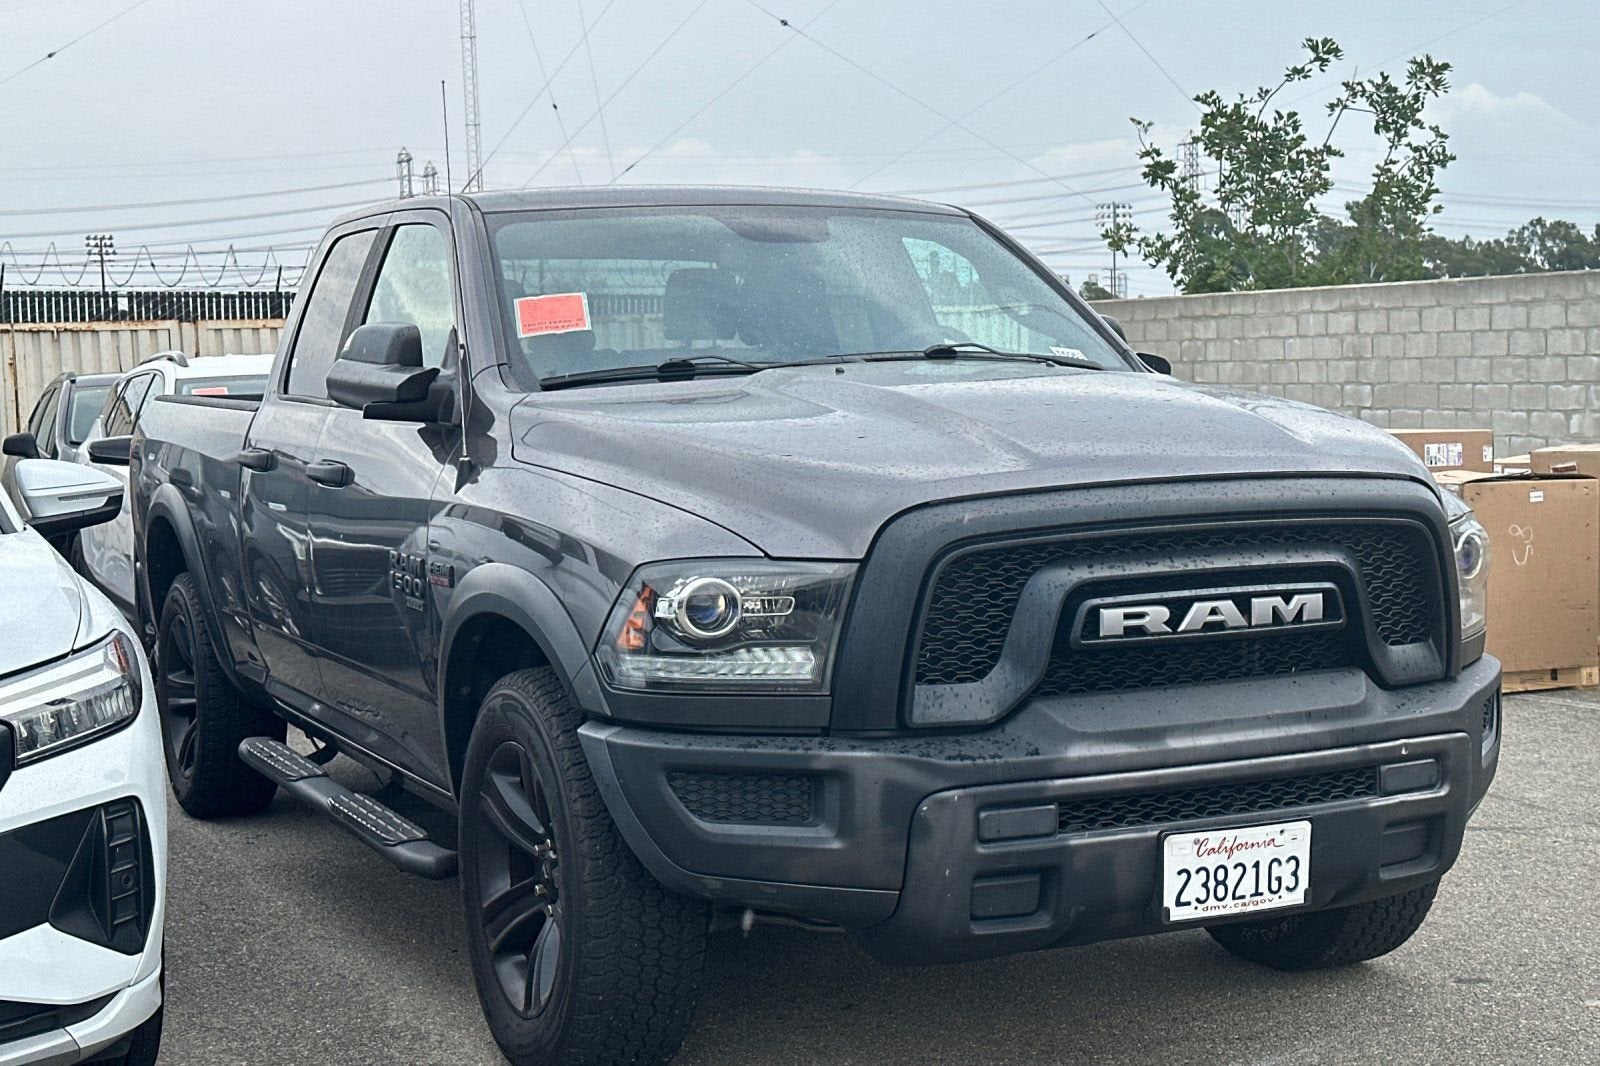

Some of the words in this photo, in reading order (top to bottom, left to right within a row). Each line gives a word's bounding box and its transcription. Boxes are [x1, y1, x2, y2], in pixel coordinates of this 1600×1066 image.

[389, 549, 425, 580] RAM
[430, 561, 454, 577] HEMI
[389, 570, 424, 599] 1500
[1099, 592, 1323, 638] RAM
[1195, 835, 1284, 861] California
[1174, 854, 1301, 908] 23821G3
